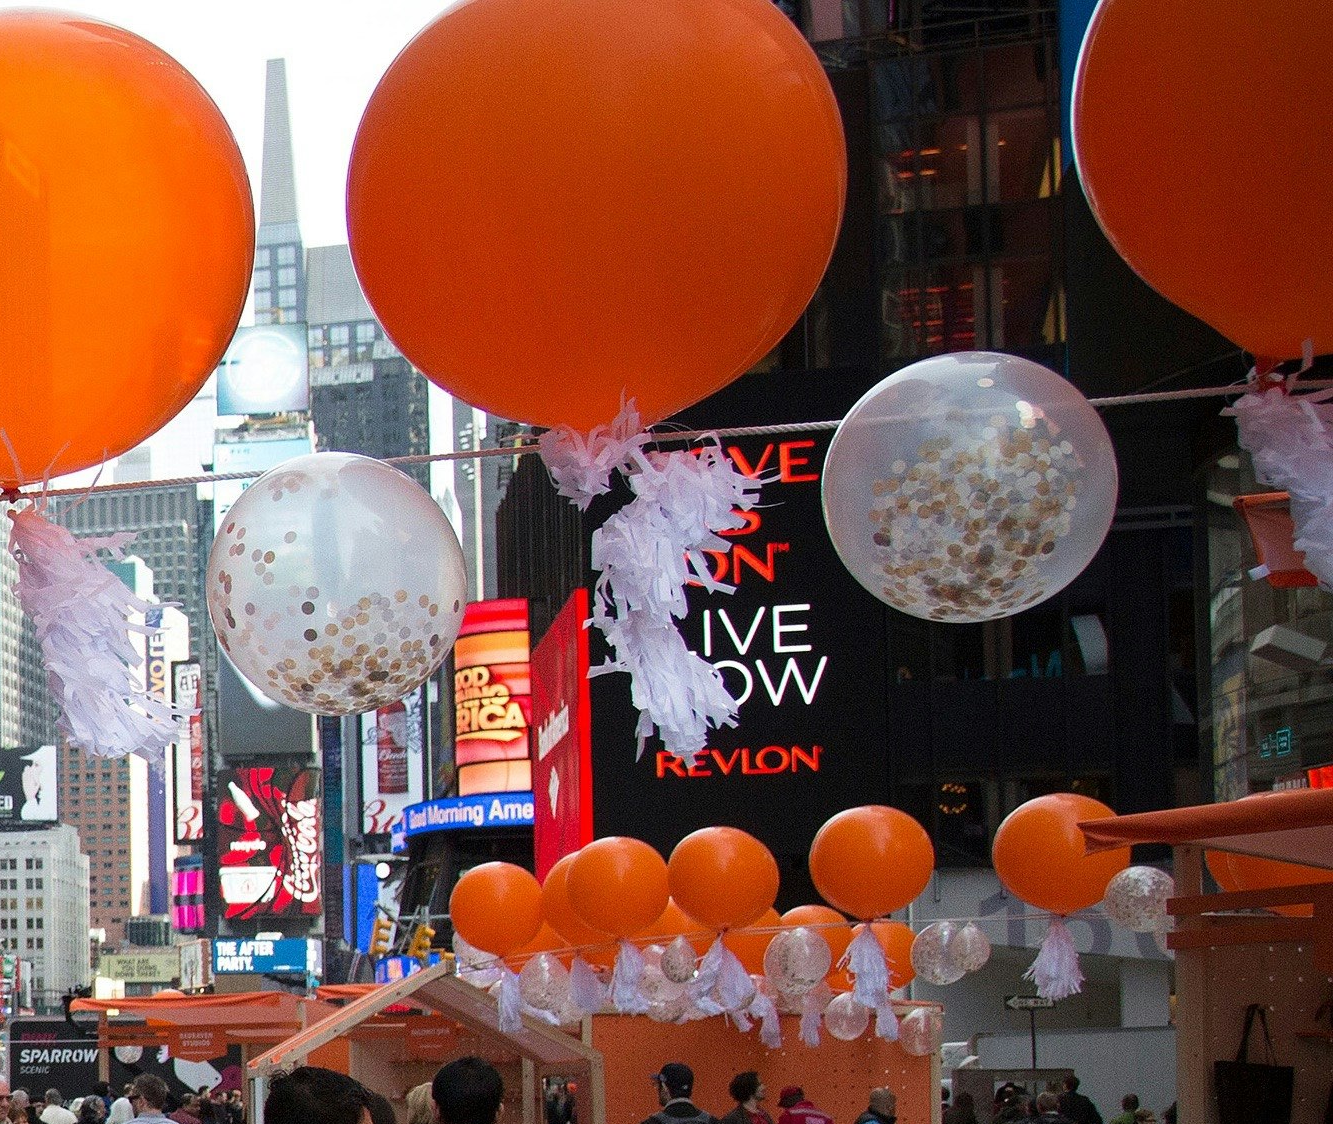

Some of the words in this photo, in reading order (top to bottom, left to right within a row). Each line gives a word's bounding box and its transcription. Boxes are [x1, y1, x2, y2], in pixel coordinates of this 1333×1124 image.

[688, 603, 813, 658] IVE
[655, 745, 823, 779] REVLON
[428, 804, 484, 827] Morning
[216, 941, 237, 957] THE
[238, 940, 274, 956] AFTER
[19, 1048, 100, 1064] SPARROW
[19, 1065, 51, 1075] SCENIC
